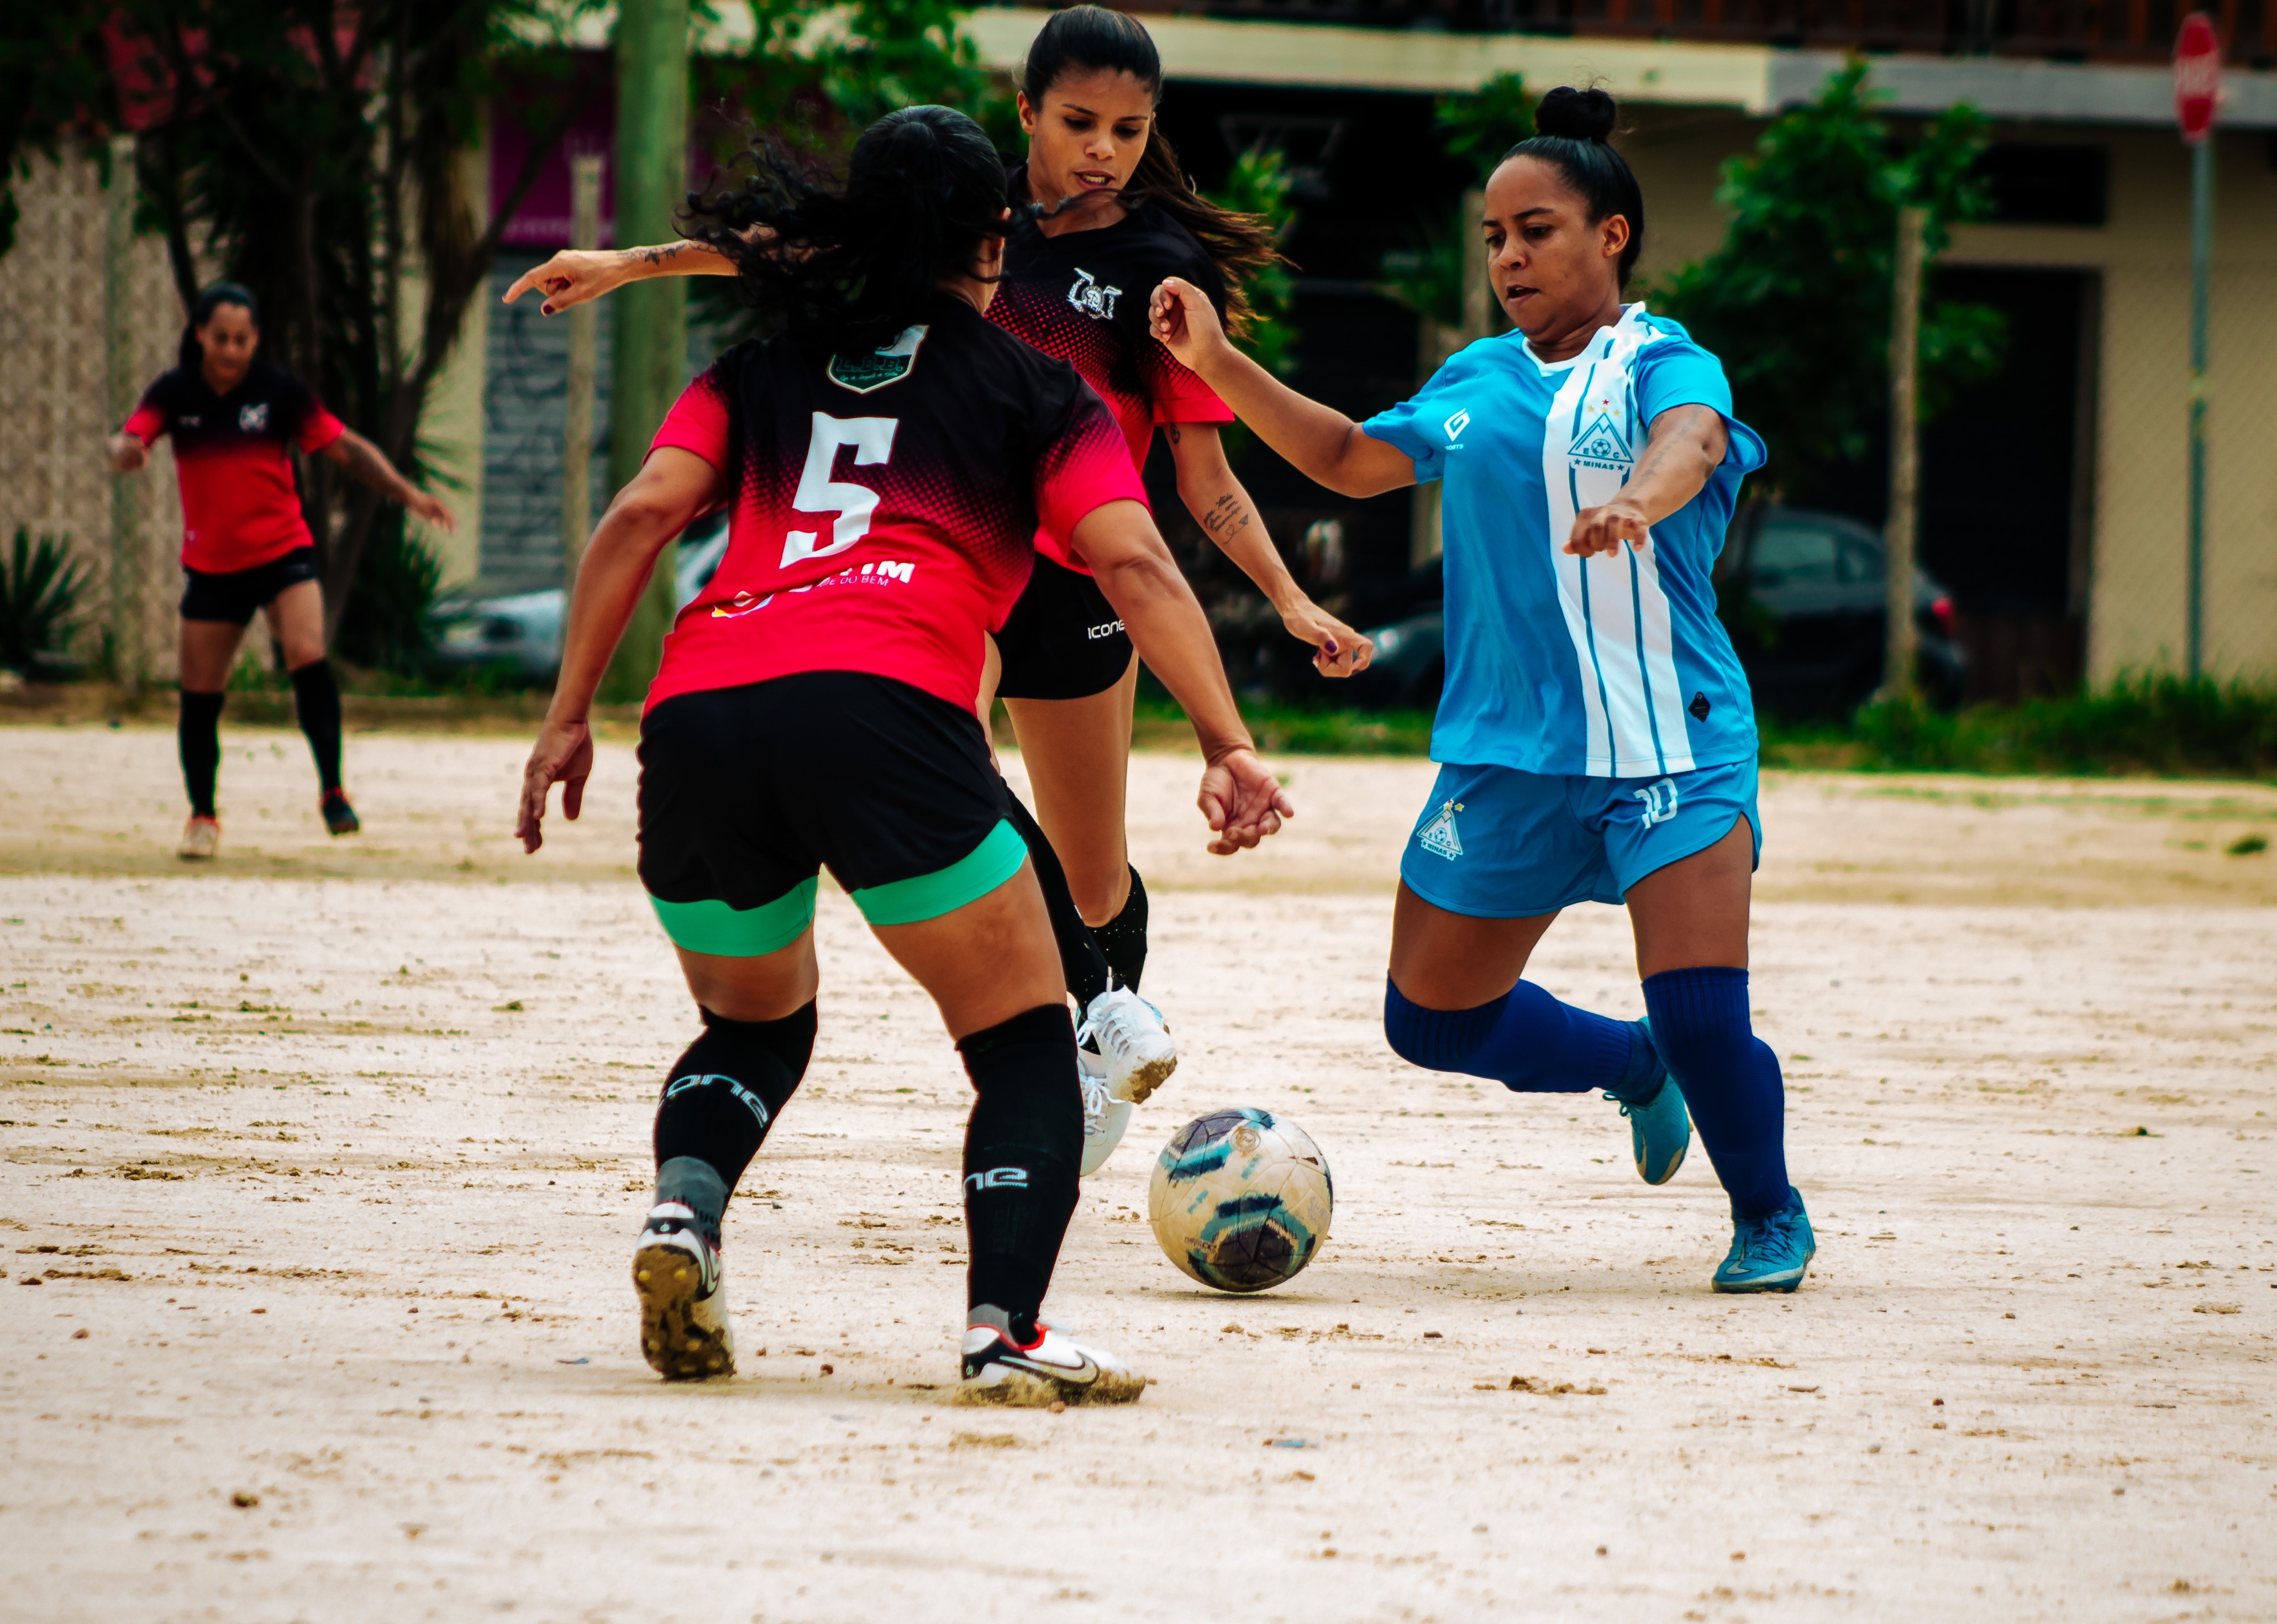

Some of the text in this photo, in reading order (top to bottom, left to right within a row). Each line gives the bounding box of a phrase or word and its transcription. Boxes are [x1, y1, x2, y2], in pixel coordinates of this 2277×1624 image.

[1583, 460, 1614, 470] MINAS
[779, 411, 900, 570] 5
[861, 575, 889, 587] BEM
[1633, 777, 1678, 829] 10
[1428, 844, 1447, 855] MINAS
[659, 1074, 768, 1129] one
